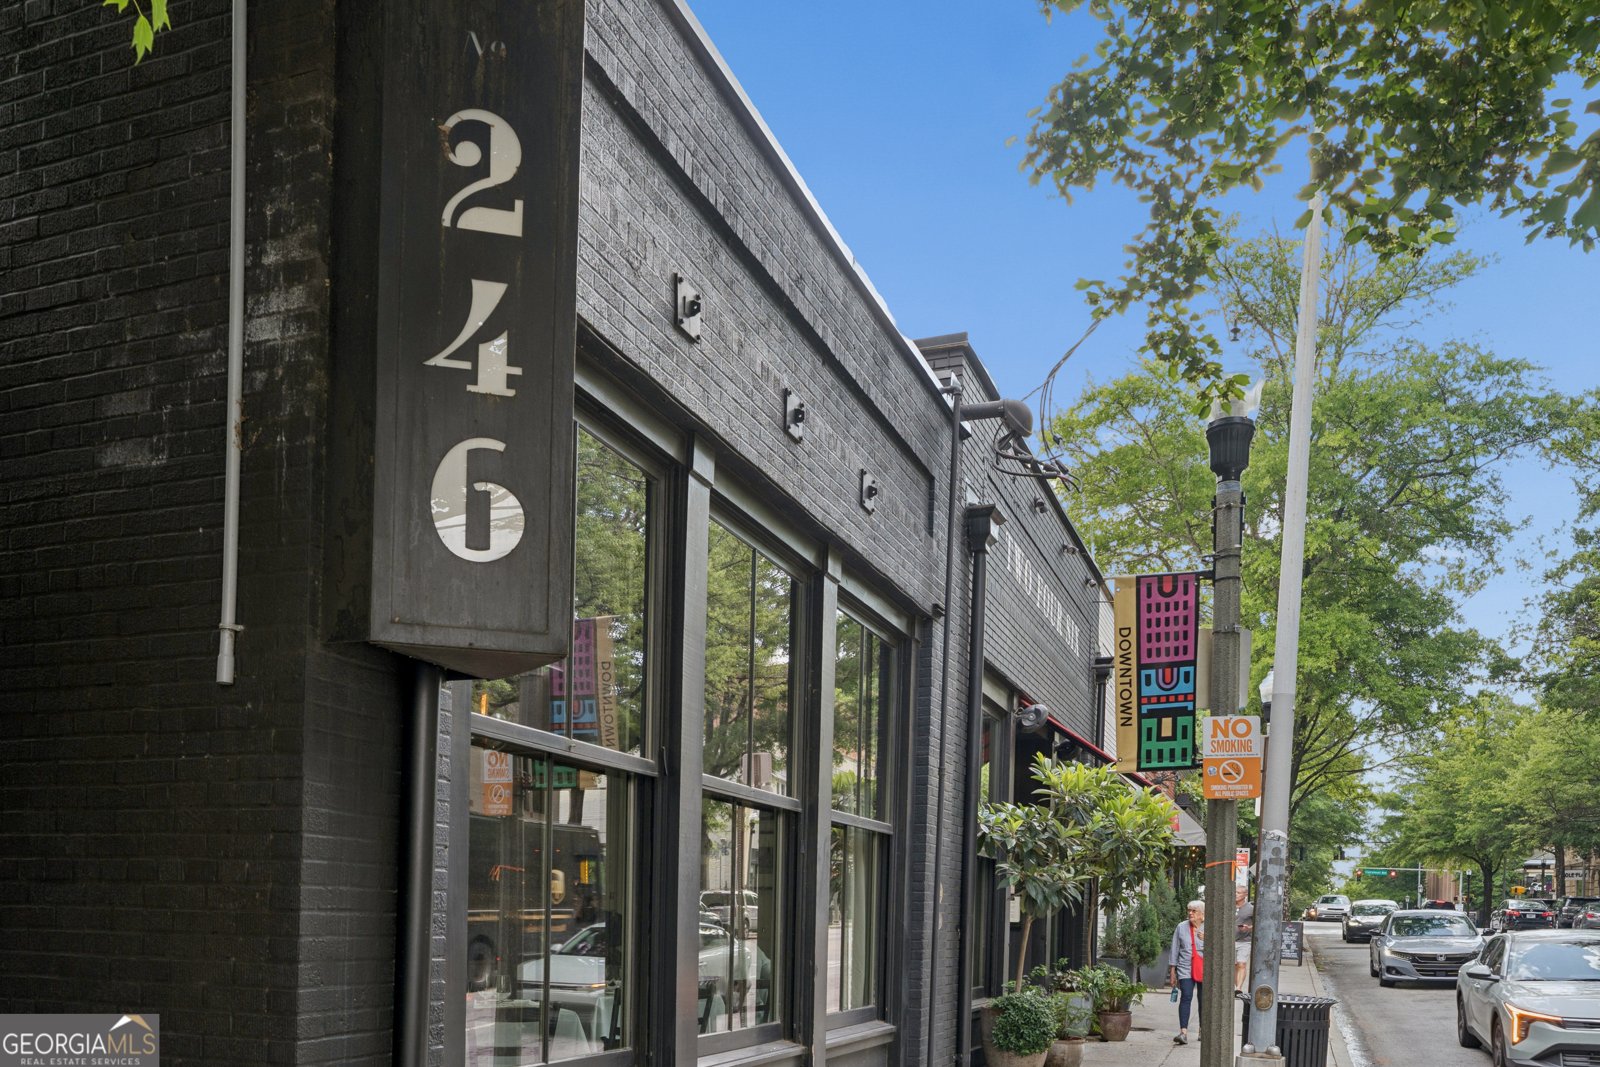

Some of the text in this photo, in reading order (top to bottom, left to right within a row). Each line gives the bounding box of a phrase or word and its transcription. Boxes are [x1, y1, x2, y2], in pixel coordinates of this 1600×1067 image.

[1005, 530, 1080, 658] TWO FOUR SIX
[1118, 626, 1133, 728] DOWNTOWN
[1210, 740, 1253, 753] SMOKING
[1211, 718, 1252, 738] NO
